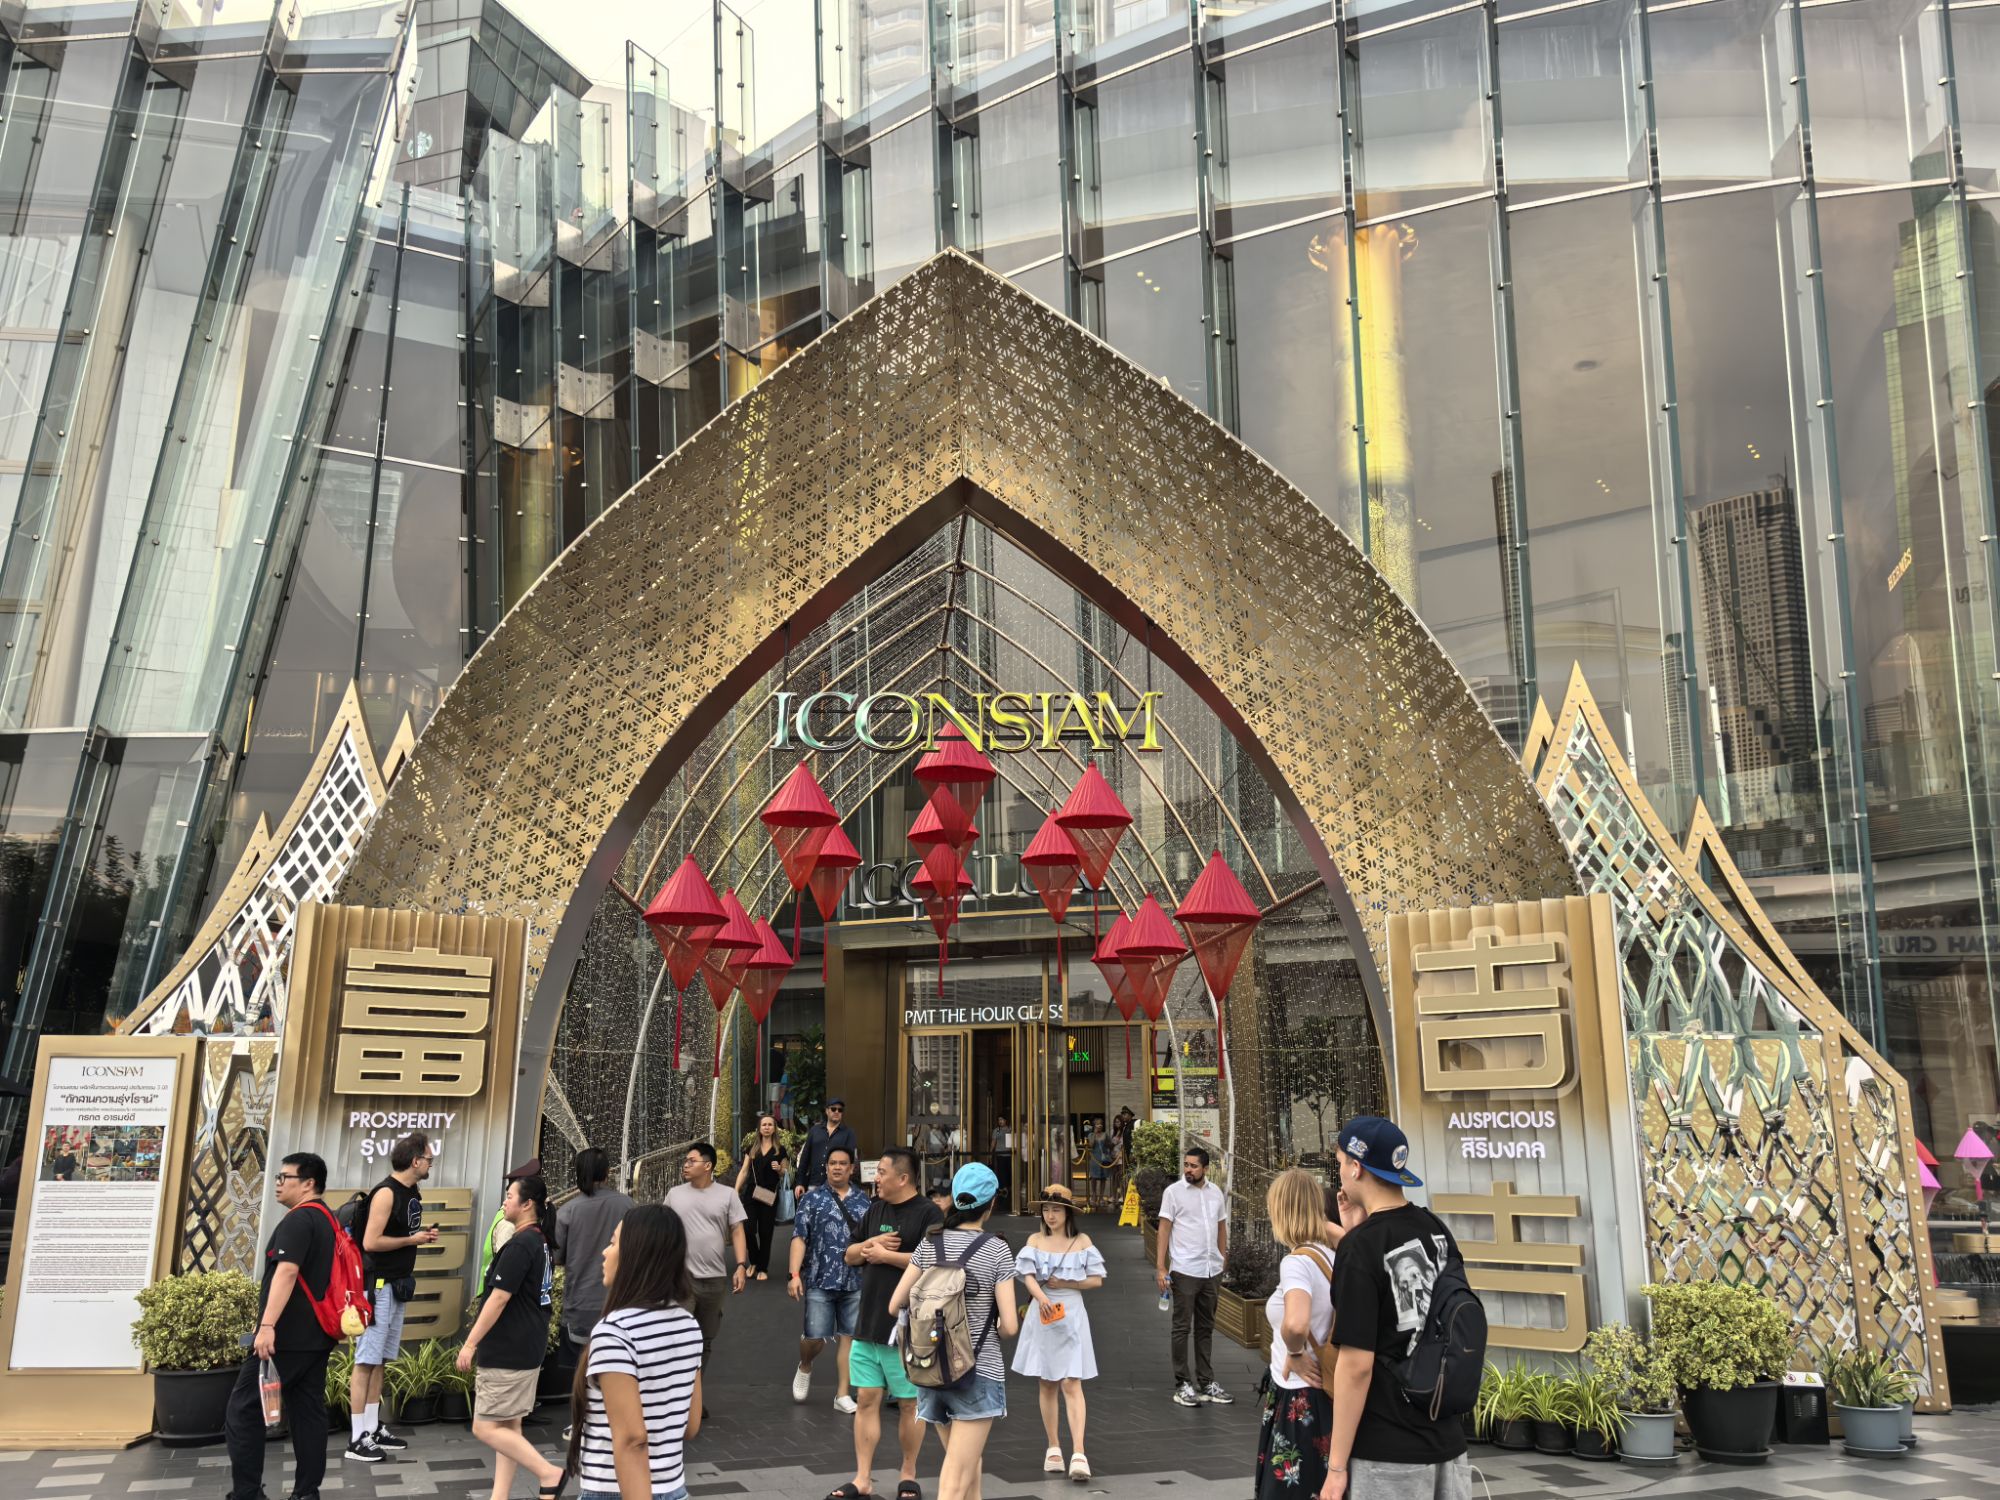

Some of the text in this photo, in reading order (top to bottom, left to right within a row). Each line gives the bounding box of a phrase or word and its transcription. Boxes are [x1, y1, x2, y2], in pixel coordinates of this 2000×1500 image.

[769, 691, 1164, 753] ICONSIAM
[333, 946, 494, 1098] 富
[904, 1009, 937, 1025] PMT
[939, 1008, 968, 1023] THE
[970, 1006, 1015, 1022] HOUR
[1414, 934, 1567, 1092] 吉
[81, 1065, 144, 1078] ICONSIAM
[349, 1111, 456, 1129] PROSPERITY
[1447, 1110, 1557, 1129] AUSPICIOUS
[1459, 1137, 1546, 1159] สิริมงคล
